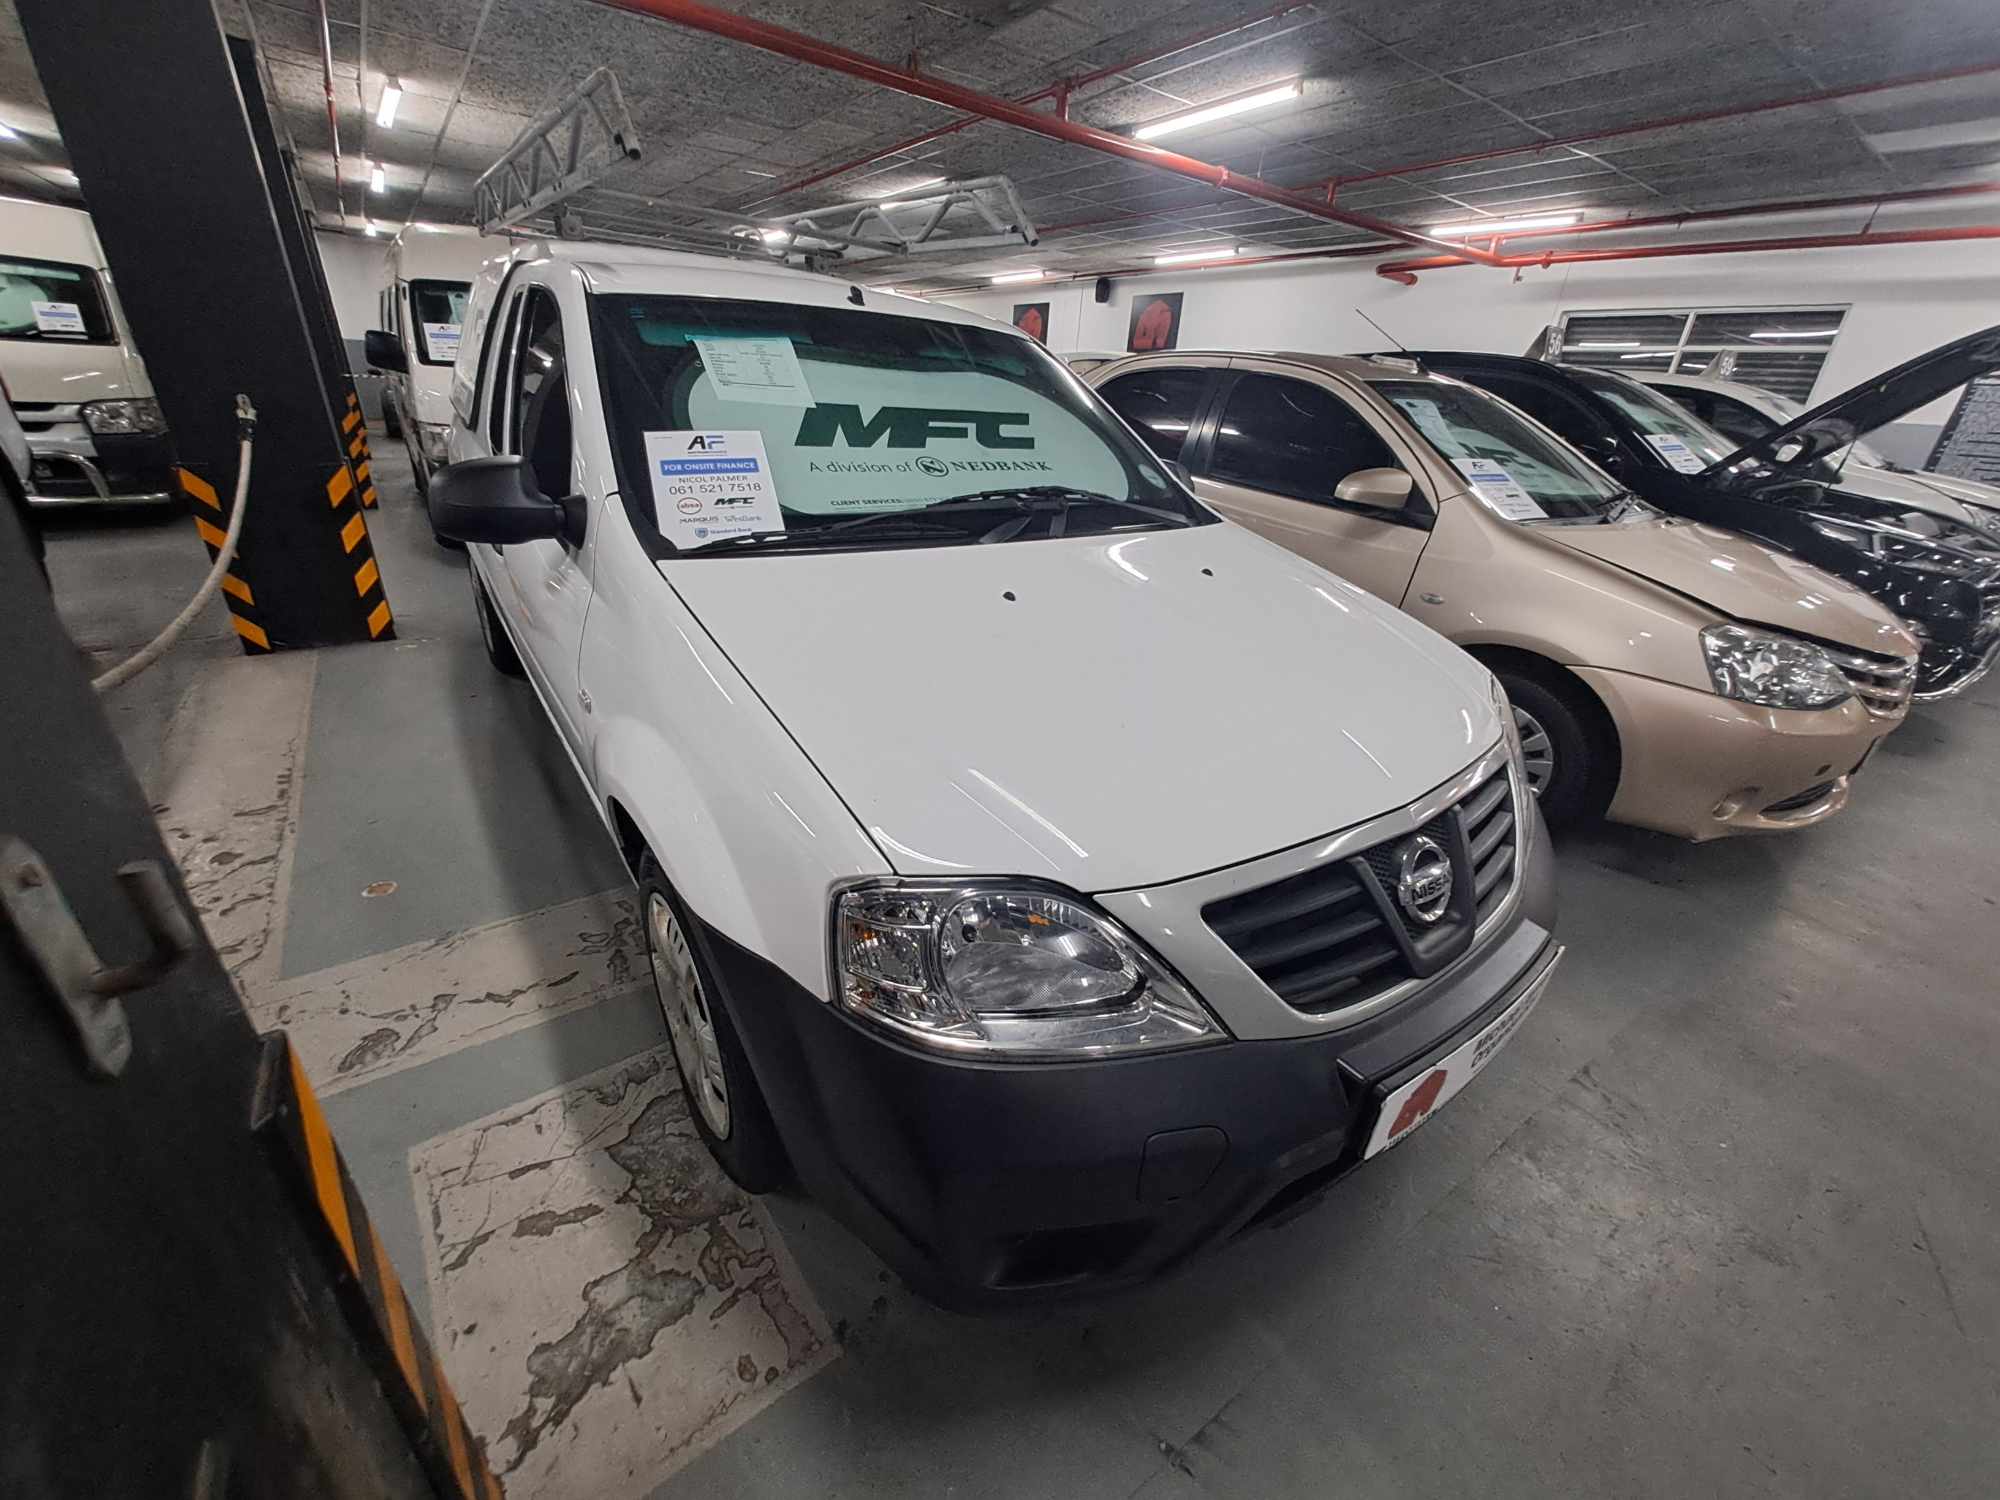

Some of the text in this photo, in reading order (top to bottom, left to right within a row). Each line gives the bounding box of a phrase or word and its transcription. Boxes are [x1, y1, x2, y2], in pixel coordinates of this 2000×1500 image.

[1549, 334, 1562, 350] 56
[1721, 358, 1735, 376] 59
[794, 402, 1035, 449] MFC
[688, 435, 724, 450] AF
[663, 461, 756, 471] FOR ONSITE FINANCE
[809, 460, 1053, 474] A division of NEDBANK
[669, 482, 762, 495] 061 521 7518
[713, 497, 756, 506] MFC
[1411, 872, 1450, 902] NISSA
